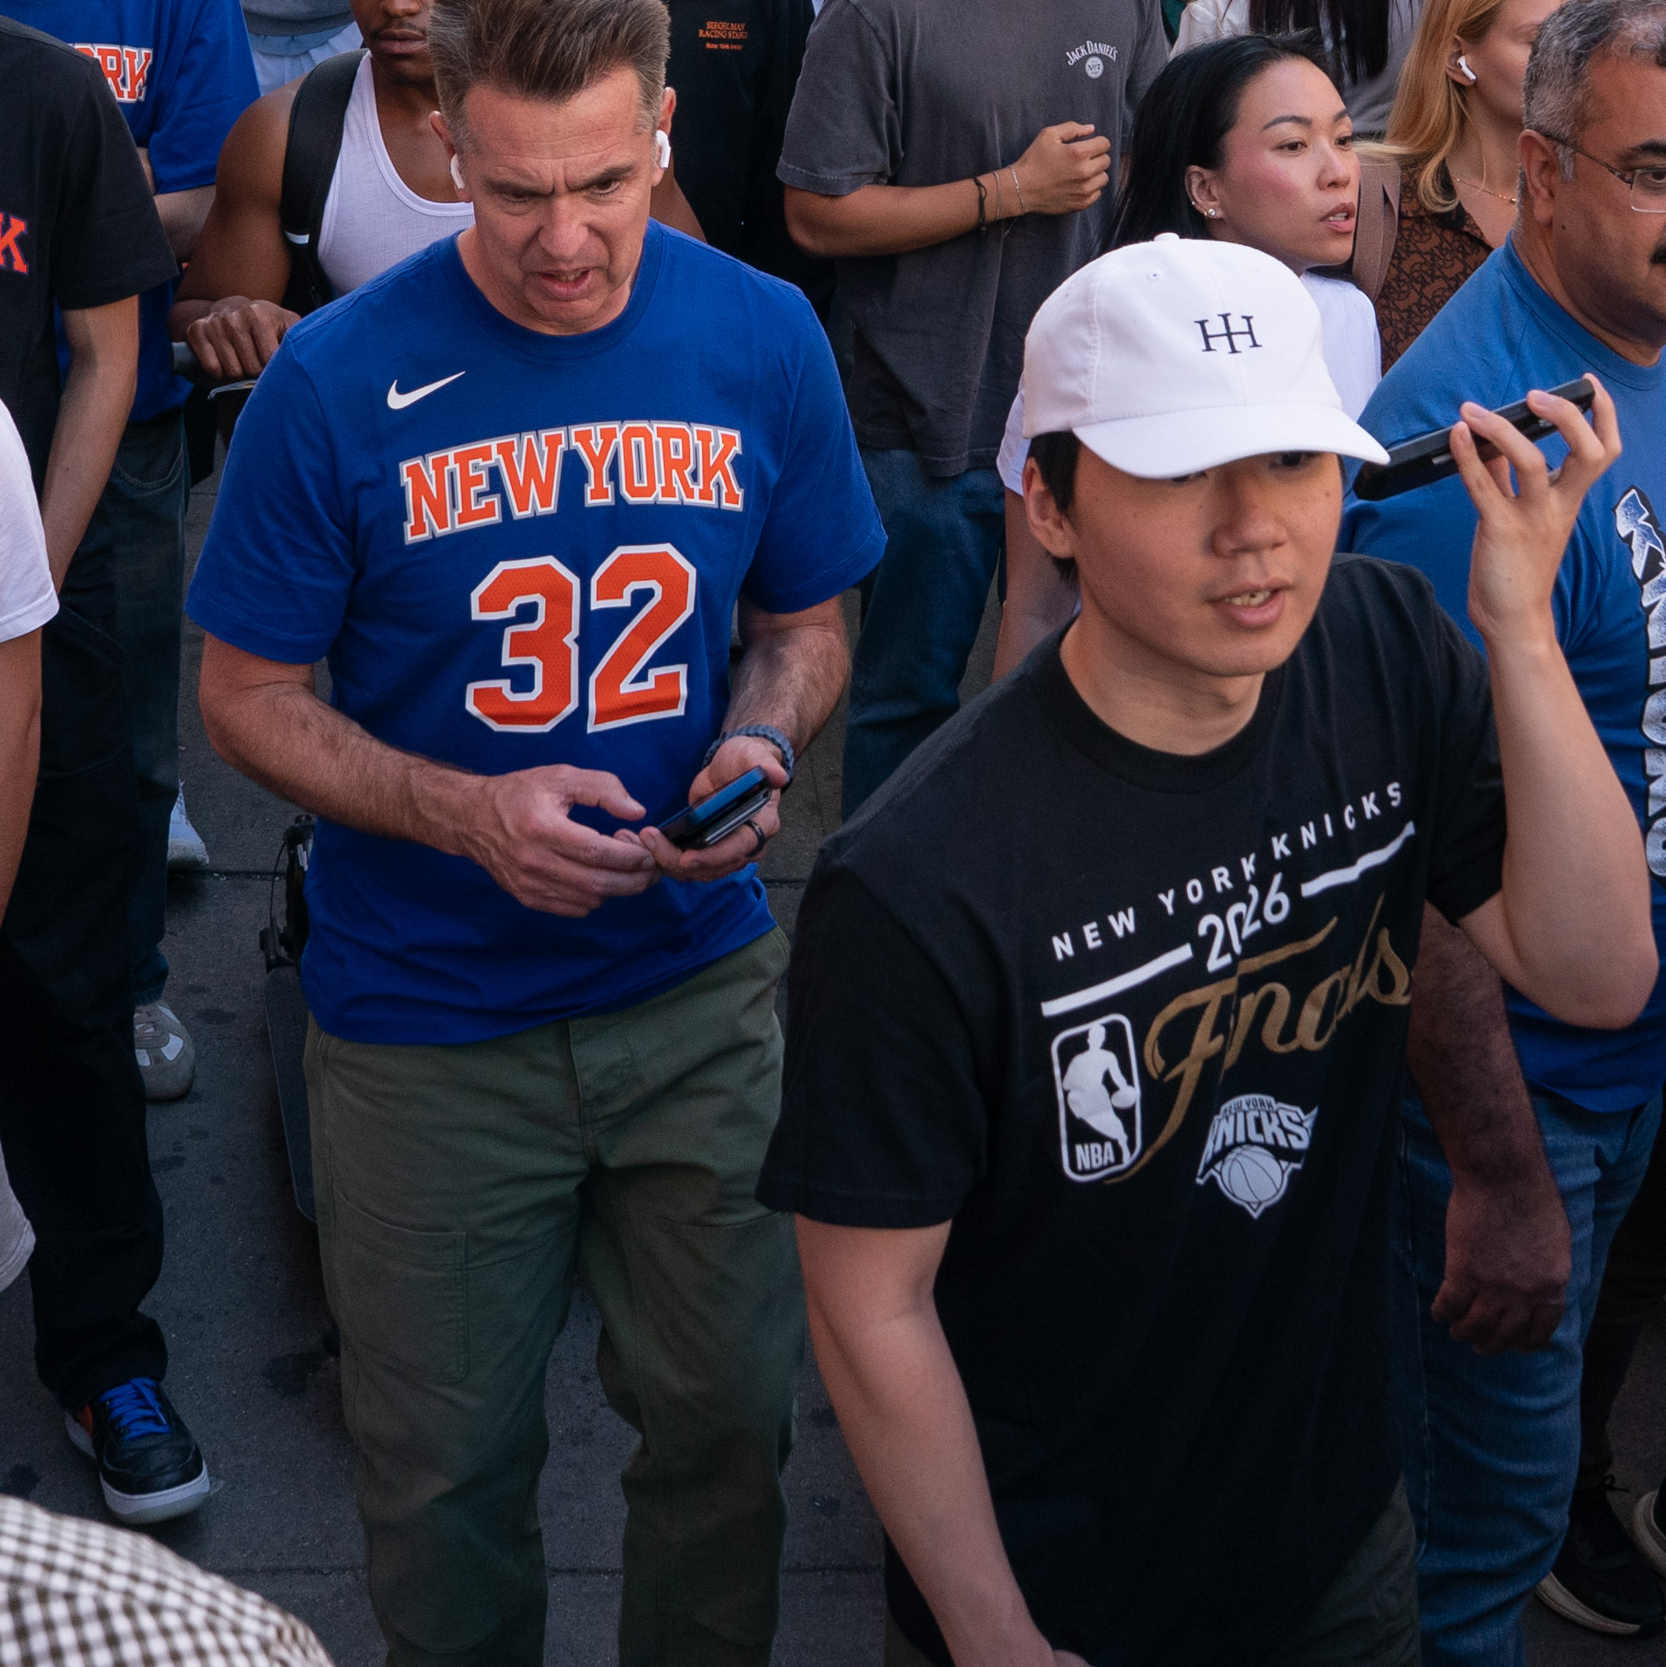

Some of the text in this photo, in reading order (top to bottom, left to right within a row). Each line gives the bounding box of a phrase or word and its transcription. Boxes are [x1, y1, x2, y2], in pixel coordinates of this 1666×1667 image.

[1067, 44, 1088, 66] JACK
[399, 418, 746, 545] NEW YORK
[465, 542, 699, 734] 32
[1053, 781, 1406, 962] NEW YORK KNICKS
[1243, 1095, 1275, 1111] YORK
[1075, 1140, 1117, 1170] NBA
